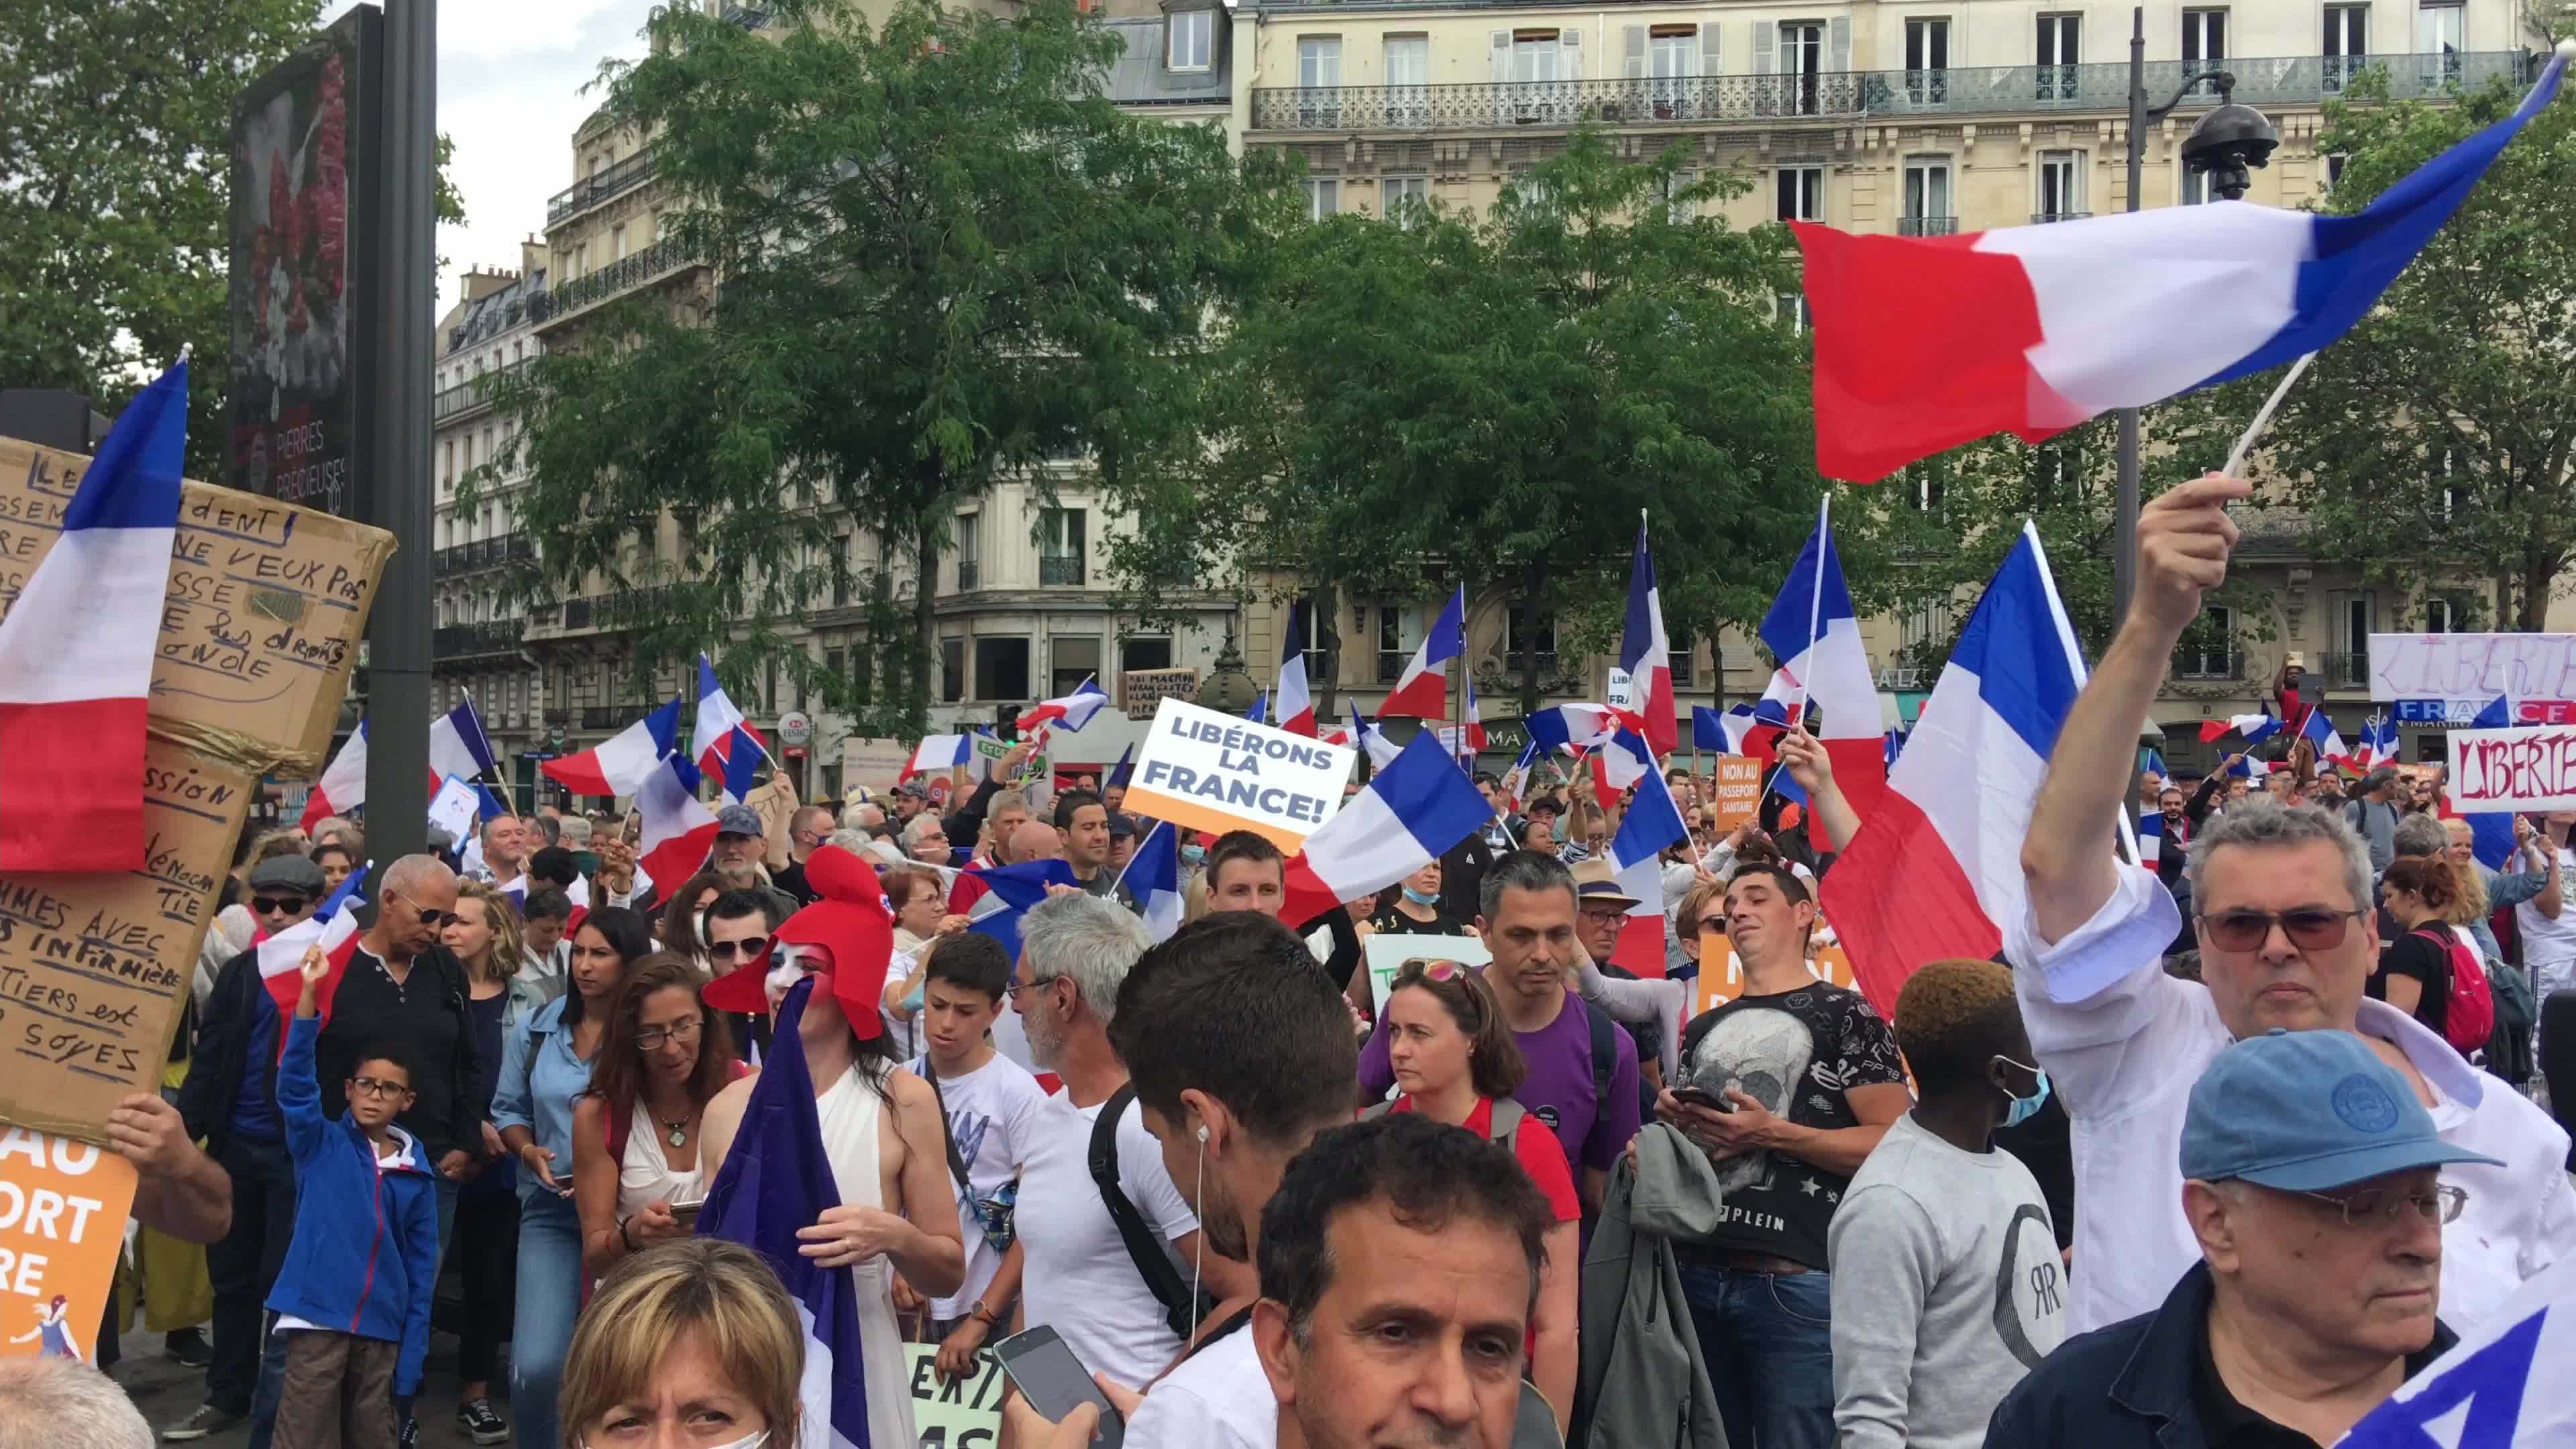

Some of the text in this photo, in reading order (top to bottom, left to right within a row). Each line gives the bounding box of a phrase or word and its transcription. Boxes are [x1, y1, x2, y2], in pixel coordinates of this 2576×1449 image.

[276, 420, 324, 462] PIERRES
[227, 547, 325, 589] VEUX
[2400, 700, 2567, 722] FRACE
[783, 729, 808, 738] HSBC
[1170, 716, 1334, 771] LIBÉRONS
[1218, 748, 1260, 776] LA
[1722, 763, 1758, 780] NON AU
[1142, 759, 1327, 824] FRANCE!
[1719, 784, 1758, 798] PASSEPORT
[1722, 801, 1753, 814] SANITAIRE
[83, 908, 165, 952] AVEC
[1731, 1208, 1785, 1232] PLEIN
